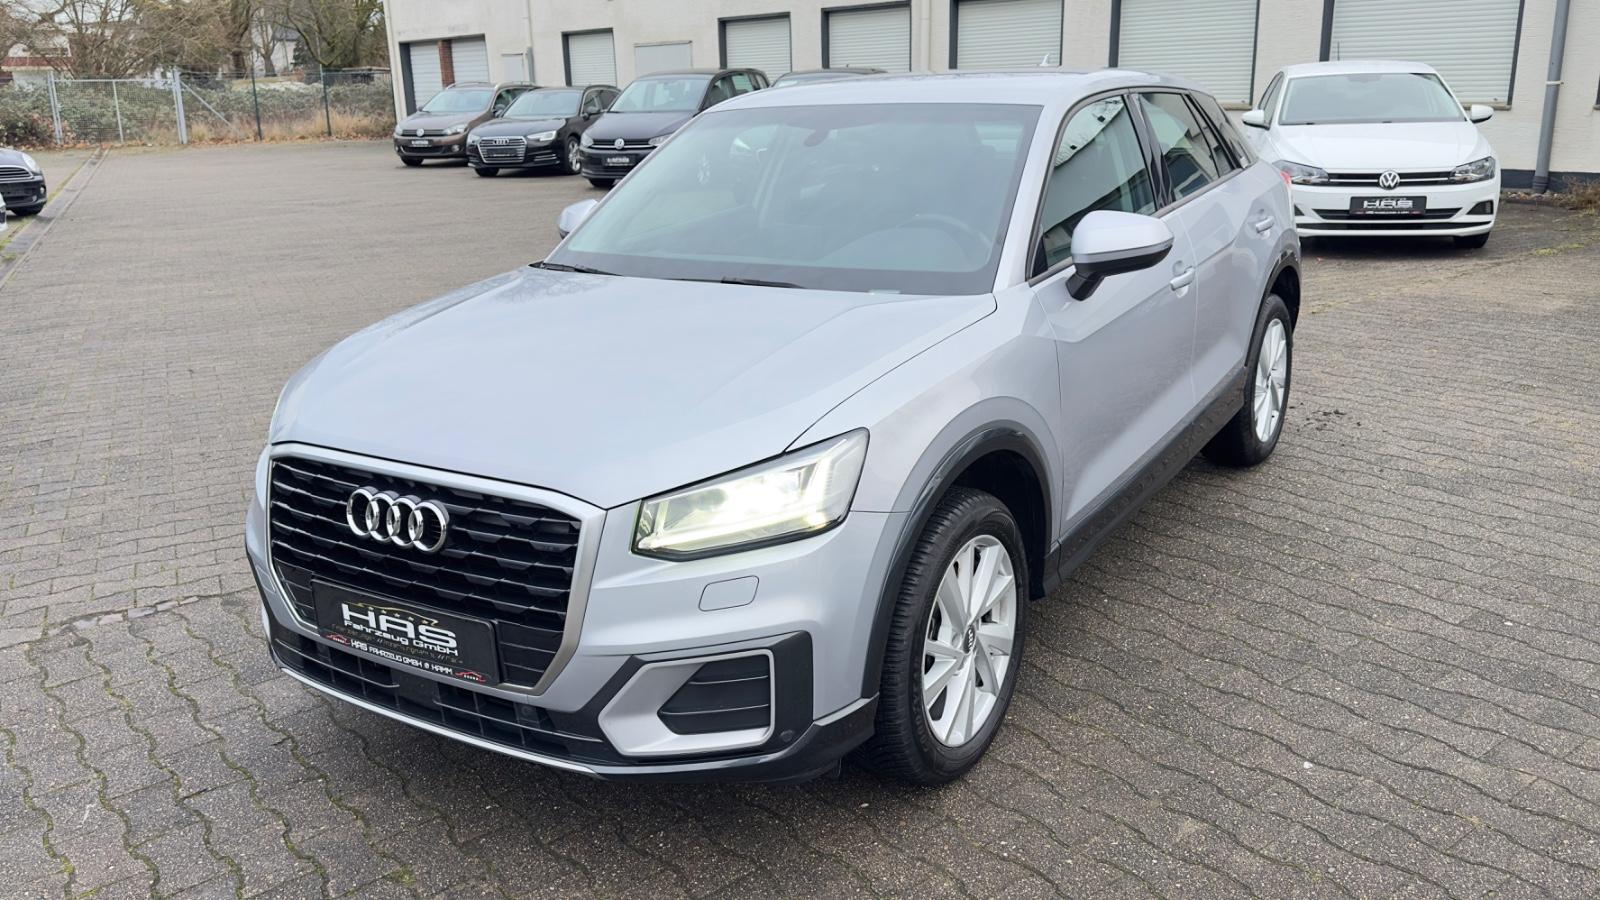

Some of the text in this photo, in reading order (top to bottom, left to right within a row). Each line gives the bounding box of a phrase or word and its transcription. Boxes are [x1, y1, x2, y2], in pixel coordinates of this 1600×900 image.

[341, 603, 457, 648] HAS
[344, 620, 409, 646] Fahrzeug
[412, 639, 459, 656] GmbH
[350, 639, 368, 651] HAS
[369, 644, 403, 662] FAHRZEUG
[403, 656, 423, 669] GMBH
[431, 664, 453, 675] HAMM
